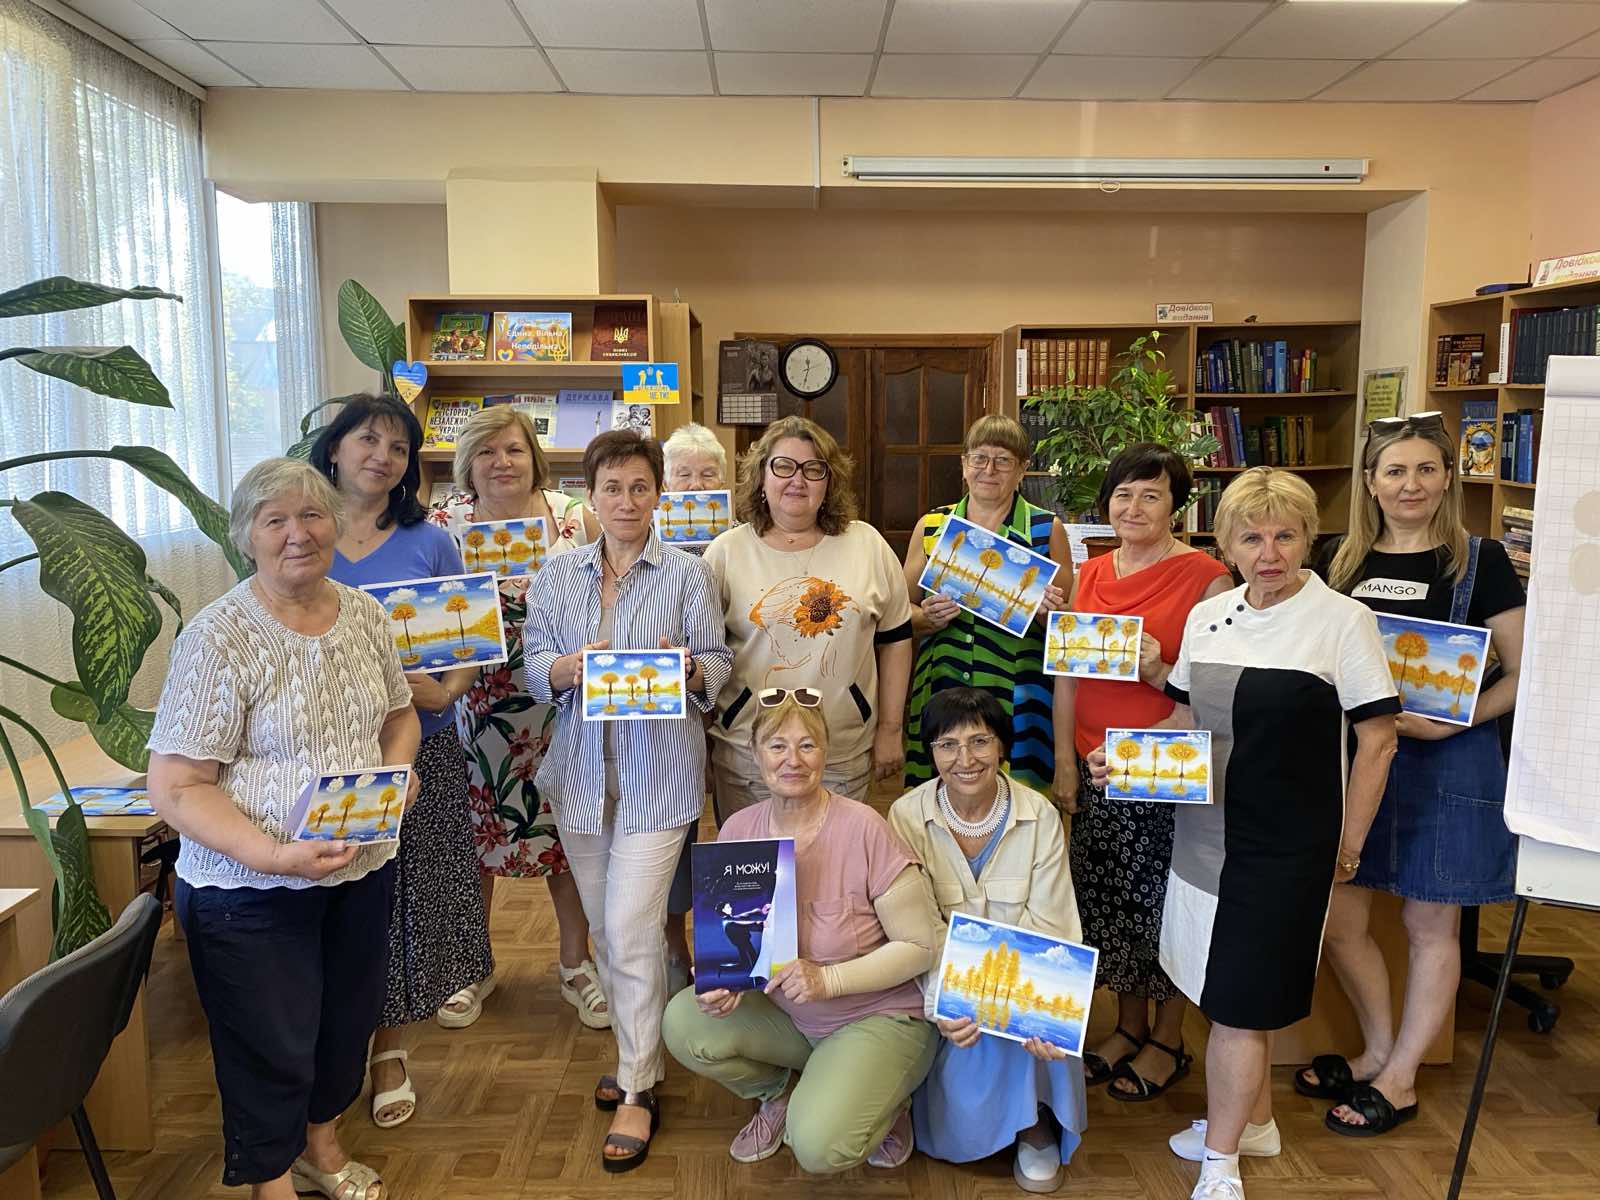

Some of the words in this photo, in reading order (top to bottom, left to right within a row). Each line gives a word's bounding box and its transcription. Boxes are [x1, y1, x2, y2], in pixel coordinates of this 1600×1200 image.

[566, 392, 609, 401] ДЕРЖАВА
[1361, 583, 1417, 596] MANGO
[723, 864, 732, 876] Я
[735, 861, 770, 876] МОЖУ!
